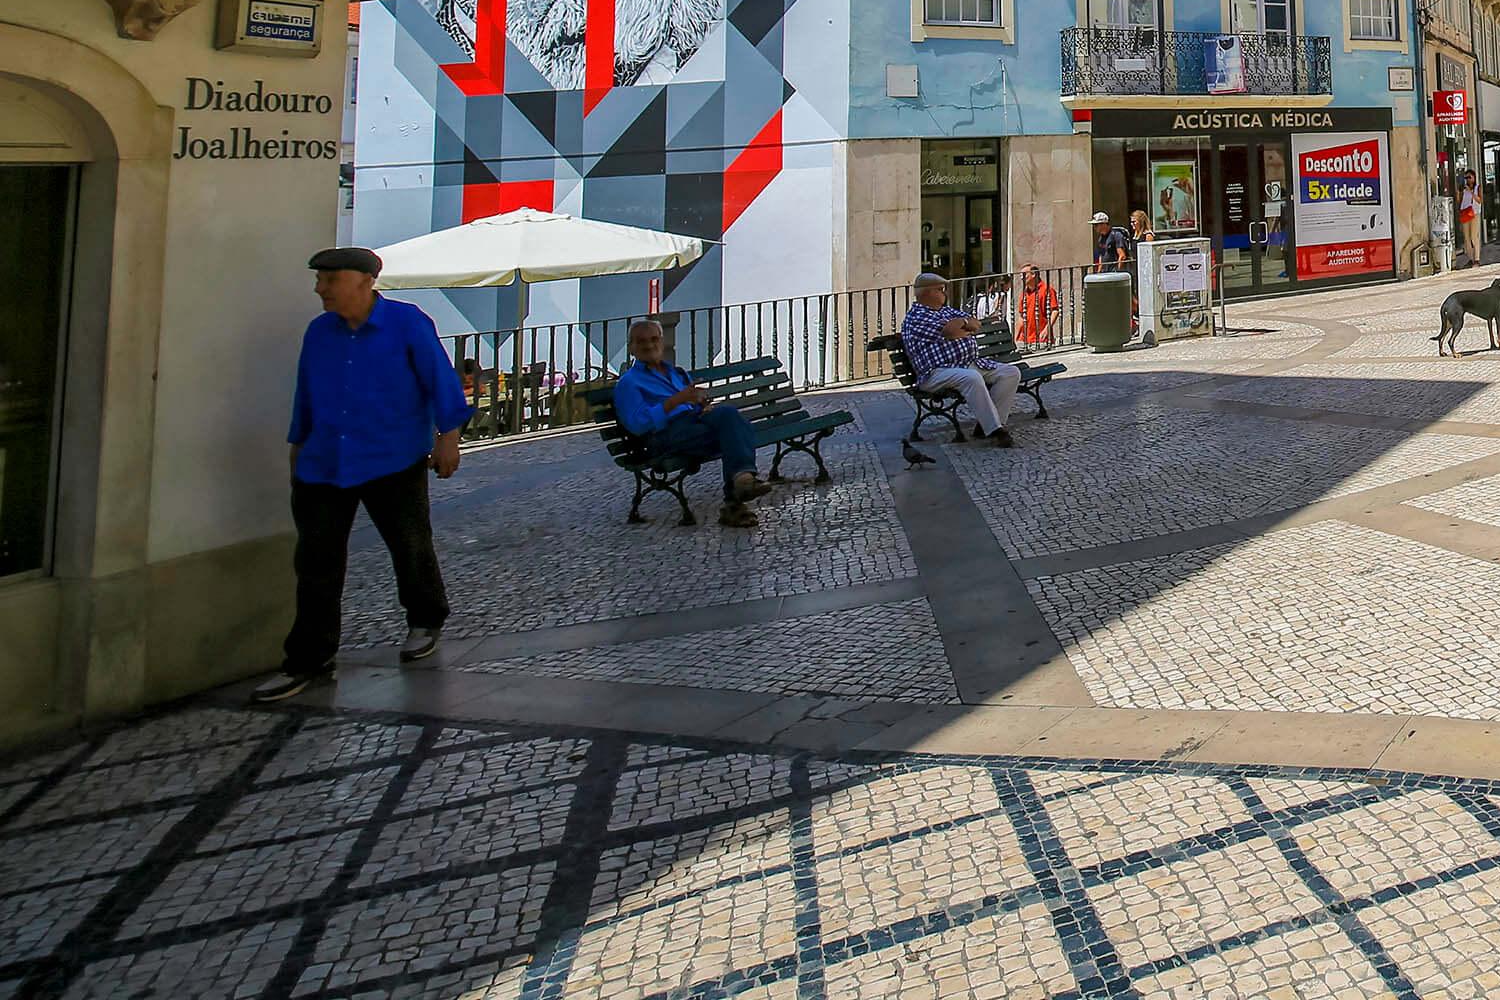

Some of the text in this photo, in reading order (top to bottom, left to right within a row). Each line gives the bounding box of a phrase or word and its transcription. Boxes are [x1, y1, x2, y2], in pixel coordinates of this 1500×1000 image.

[250, 25, 311, 39] segurança
[184, 77, 332, 114] Diadouro
[1173, 110, 1333, 129] ACÚSTICA MÉDICA
[173, 126, 337, 160] Joalheiros
[1305, 149, 1373, 173] Desconto
[1308, 180, 1373, 200] 5x idade
[1327, 248, 1365, 258] APARELHOS
[1328, 256, 1364, 266] AUDITIVOS
